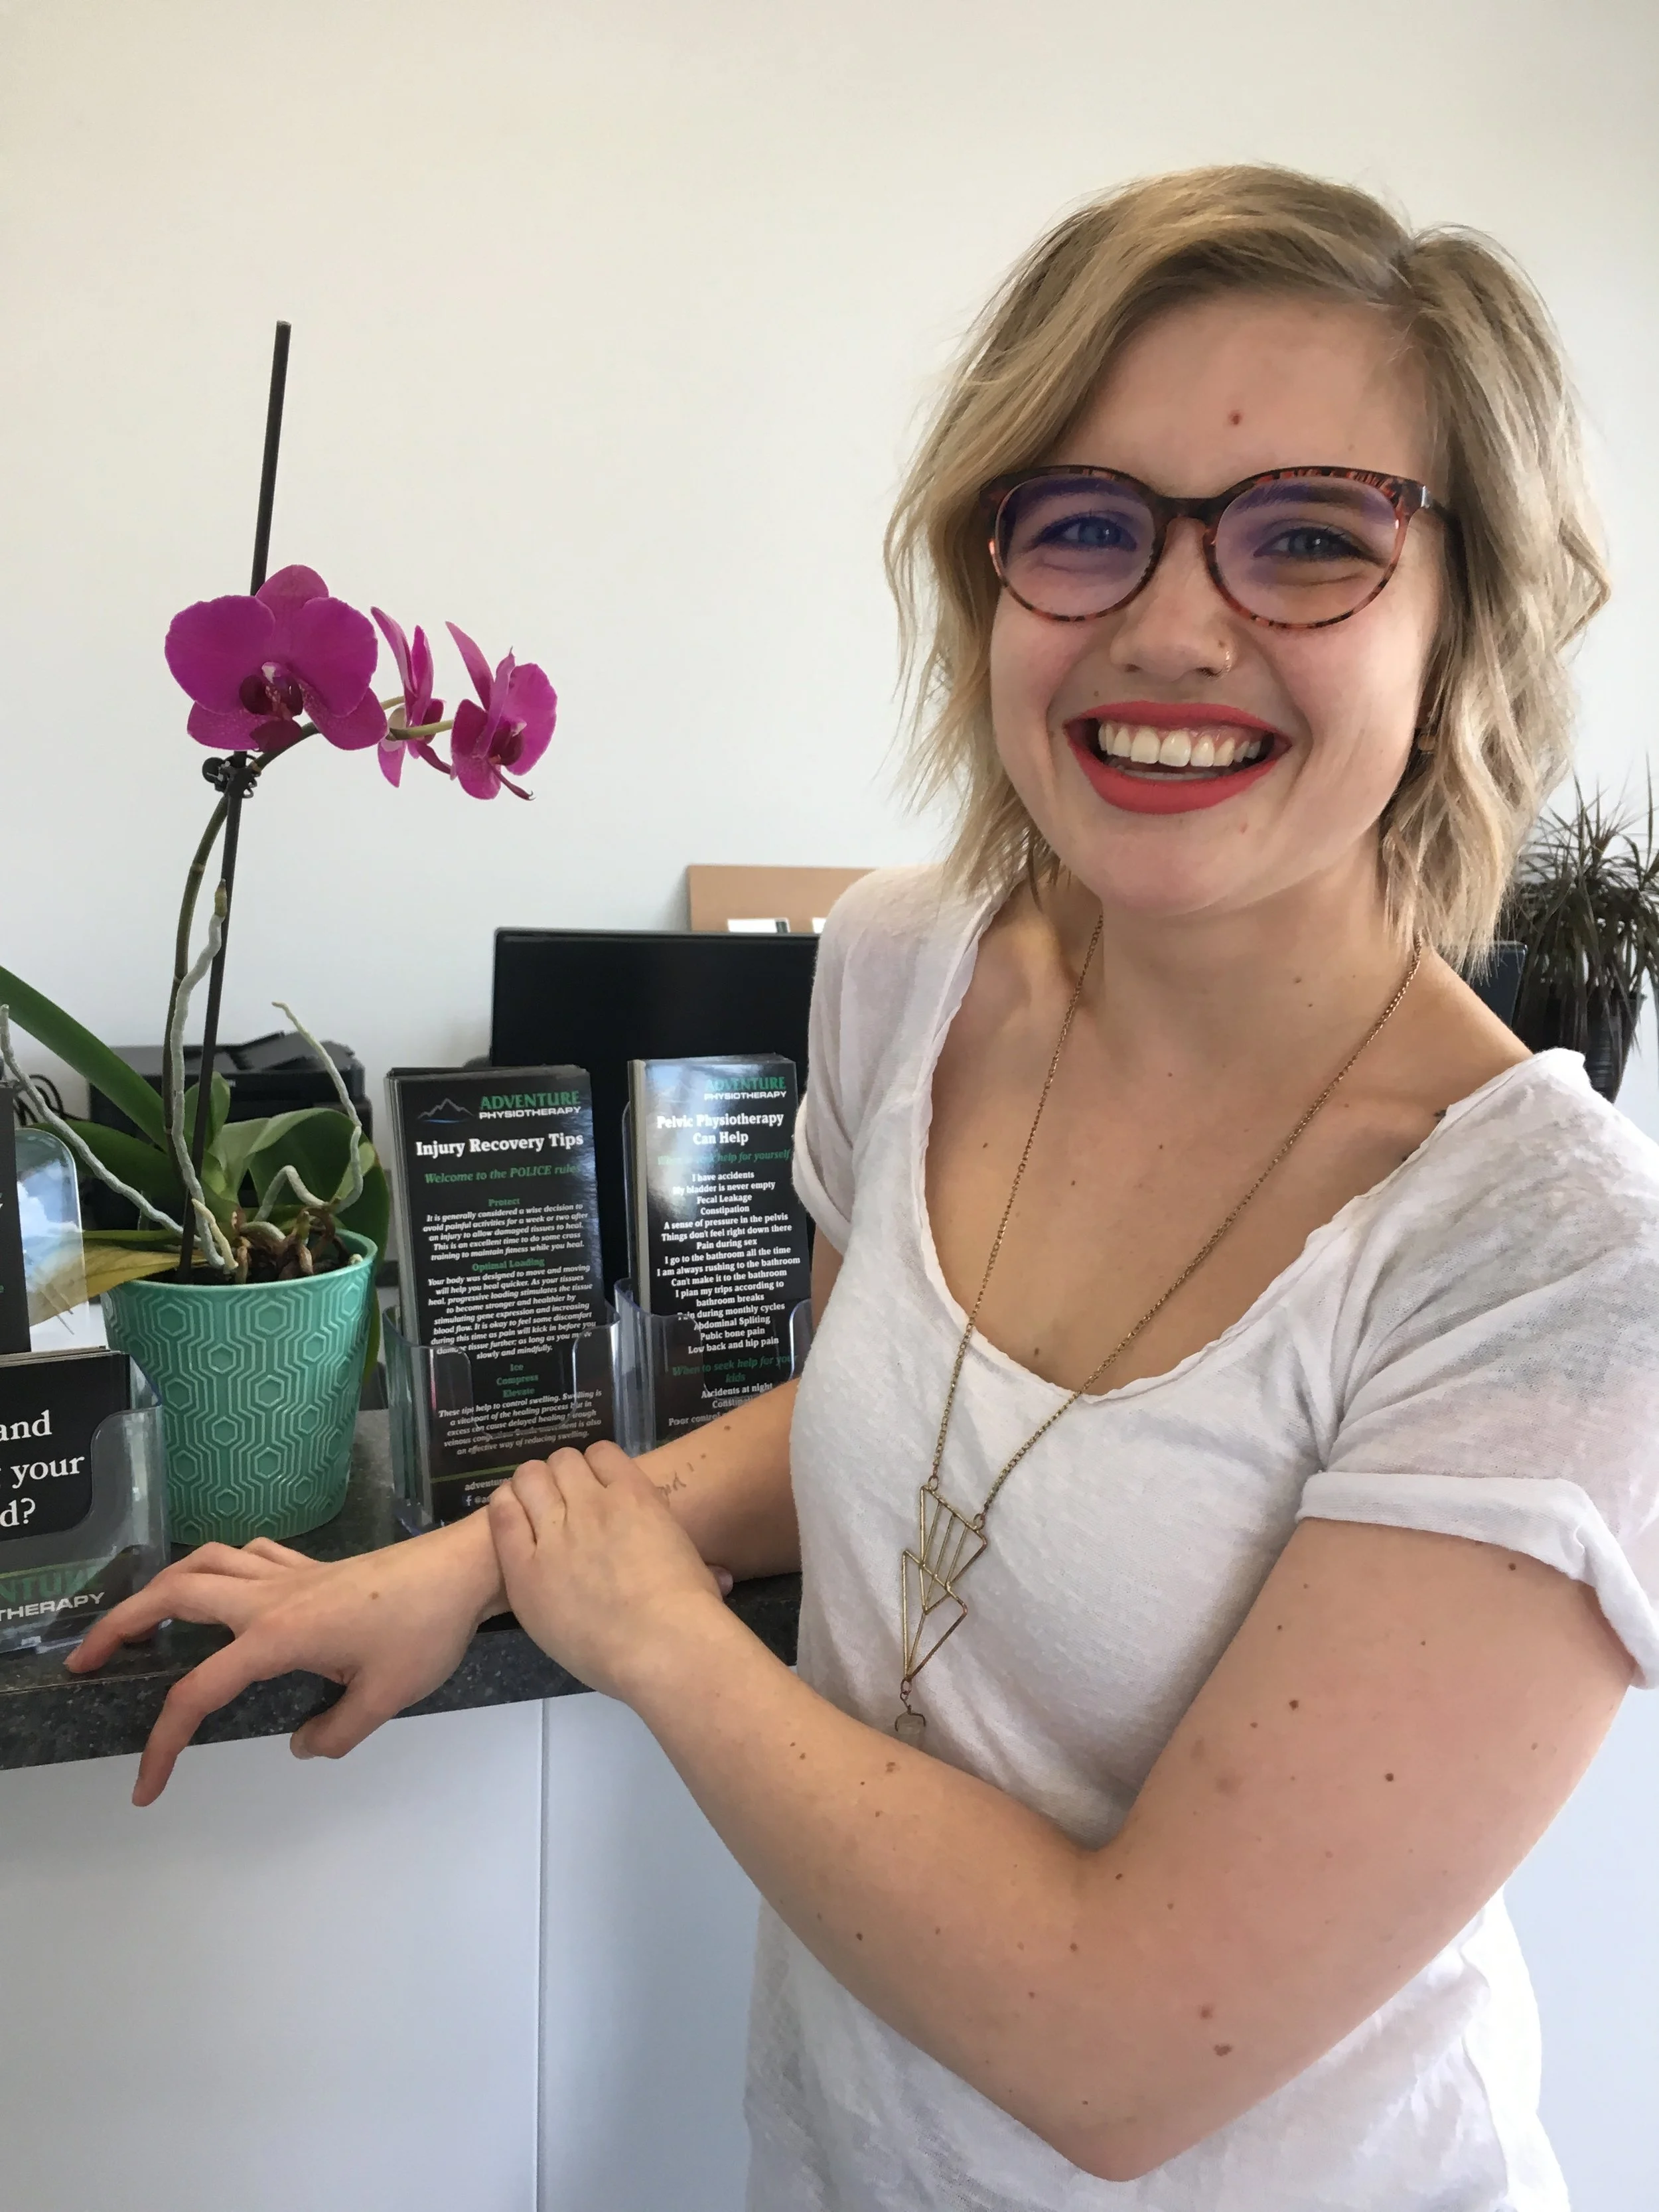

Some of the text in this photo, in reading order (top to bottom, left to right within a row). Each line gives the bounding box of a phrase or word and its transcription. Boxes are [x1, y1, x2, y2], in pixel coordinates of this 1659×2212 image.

[480, 1090, 580, 1110] ADVENTURE
[703, 1091, 786, 1100] PHYSIOTHERAPY
[479, 1106, 581, 1120] PHYSIOTHERAPY
[657, 1112, 784, 1129] Pelvic Physiotherapy
[416, 1132, 584, 1158] Injury Recovery Tips
[692, 1131, 749, 1145] Can Help
[738, 1151, 752, 1163] for
[754, 1149, 790, 1161] yourself
[425, 1173, 473, 1183] Welcome
[490, 1169, 507, 1179] the
[510, 1165, 551, 1177] POLICE
[686, 1184, 717, 1193] bladder
[751, 1181, 776, 1191] empty
[696, 1194, 752, 1204] Fecal Leakage
[442, 1211, 476, 1222] generally
[477, 1207, 518, 1217] considered
[543, 1203, 573, 1212] decision
[700, 1205, 749, 1215] Constipation
[423, 1223, 444, 1232] avoid
[445, 1220, 471, 1232] painful
[472, 1218, 505, 1227] activities
[506, 1218, 518, 1227] for
[571, 1213, 589, 1221] after
[663, 1221, 670, 1230] A
[704, 1218, 738, 1228] pressure
[764, 1213, 788, 1224] pelvis
[440, 1232, 462, 1241] injury
[494, 1225, 529, 1235] damaged
[565, 1221, 584, 1230] heal.
[661, 1232, 687, 1241] Things
[689, 1230, 708, 1238] don't
[710, 1228, 725, 1237] feel
[726, 1227, 745, 1236] right
[469, 1238, 502, 1247] excellent
[696, 1240, 714, 1250] Pain
[715, 1238, 742, 1248] during
[431, 1251, 461, 1260] training
[470, 1247, 504, 1257] maintain
[504, 1246, 529, 1256] fitness
[550, 1243, 565, 1252] you
[566, 1240, 585, 1248] heal.
[664, 1256, 668, 1264] I
[691, 1253, 704, 1262] the
[705, 1251, 744, 1260] bathroom
[472, 1258, 545, 1272] Optimal Loading
[676, 1266, 703, 1275] always
[705, 1262, 735, 1272] rushing
[760, 1258, 800, 1266] bathroom
[671, 1277, 690, 1286] Can't
[691, 1275, 713, 1284] make
[715, 1274, 721, 1282] it
[733, 1272, 746, 1280] the
[747, 1270, 786, 1278] bathroom
[680, 1288, 698, 1299] plan
[700, 1288, 713, 1297] my
[714, 1285, 733, 1295] trips
[735, 1281, 774, 1291] according
[696, 1293, 764, 1306] bathroom breaks
[697, 1309, 723, 1318] during
[725, 1305, 758, 1315] monthly
[760, 1302, 784, 1313] cycles
[699, 1327, 764, 1341] Pubic bone pain
[687, 1337, 779, 1354] Low back and hip pain
[713, 1361, 735, 1370] seek
[737, 1359, 758, 1369] help
[758, 1357, 774, 1368] for
[725, 1373, 746, 1382] kids
[10, 1456, 85, 1489] your
